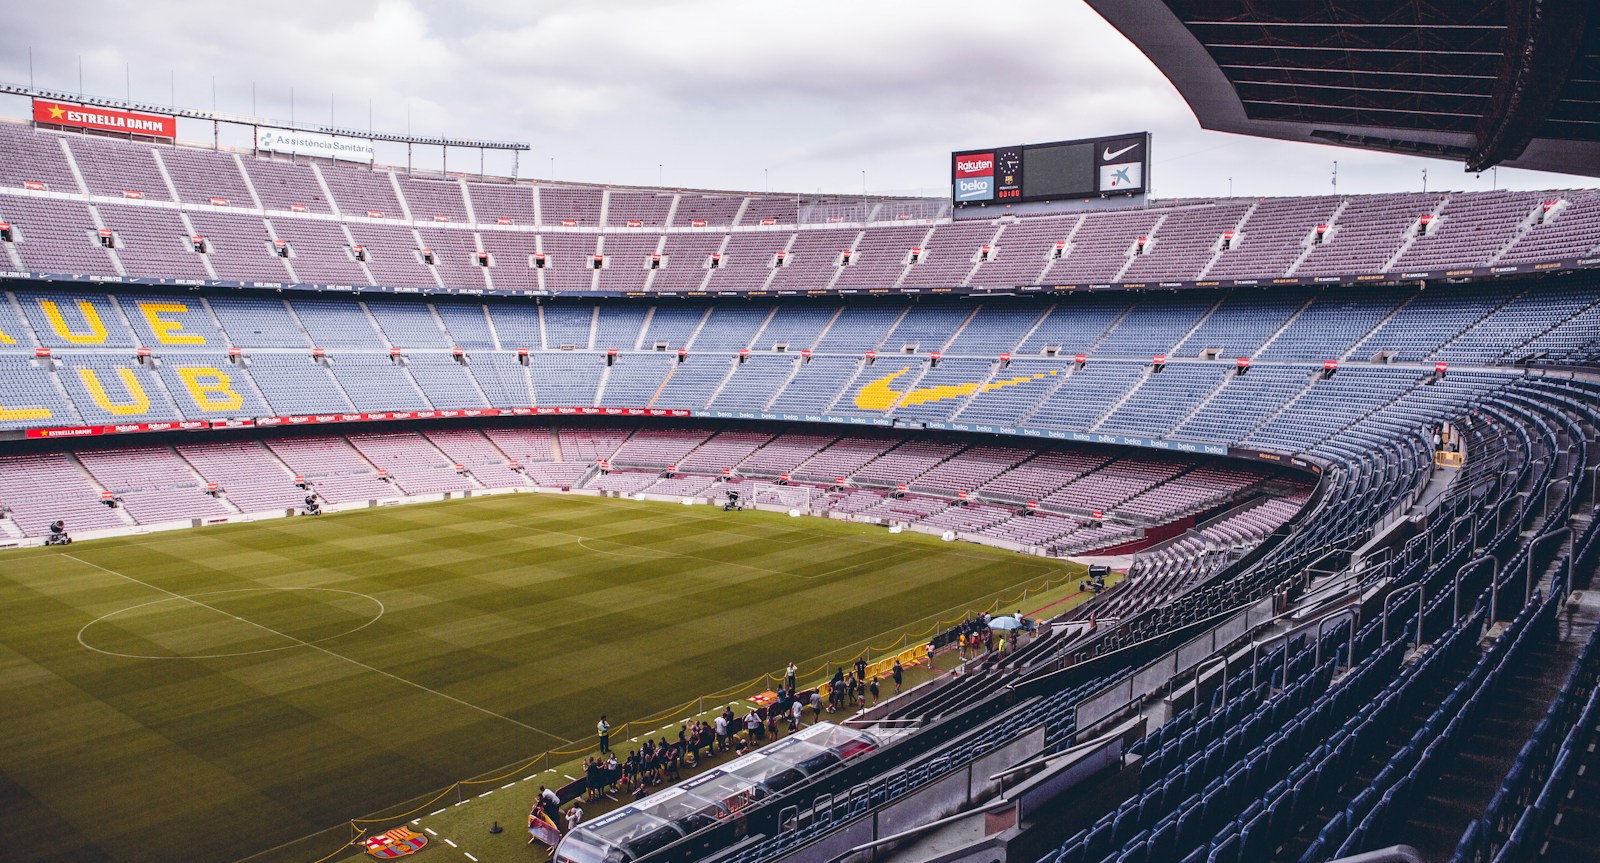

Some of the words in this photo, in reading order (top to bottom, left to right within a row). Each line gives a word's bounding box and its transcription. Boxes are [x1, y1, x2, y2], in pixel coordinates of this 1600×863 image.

[68, 111, 124, 127] ESTRELLA
[127, 119, 163, 131] DAMM
[277, 136, 332, 149] Assistència
[958, 160, 992, 172] Rakuten
[960, 180, 987, 191] beko
[0, 300, 206, 344] UE
[1099, 435, 1115, 443] beko
[1151, 440, 1168, 448] beko
[1178, 443, 1195, 451] beko
[1205, 445, 1223, 454] beko
